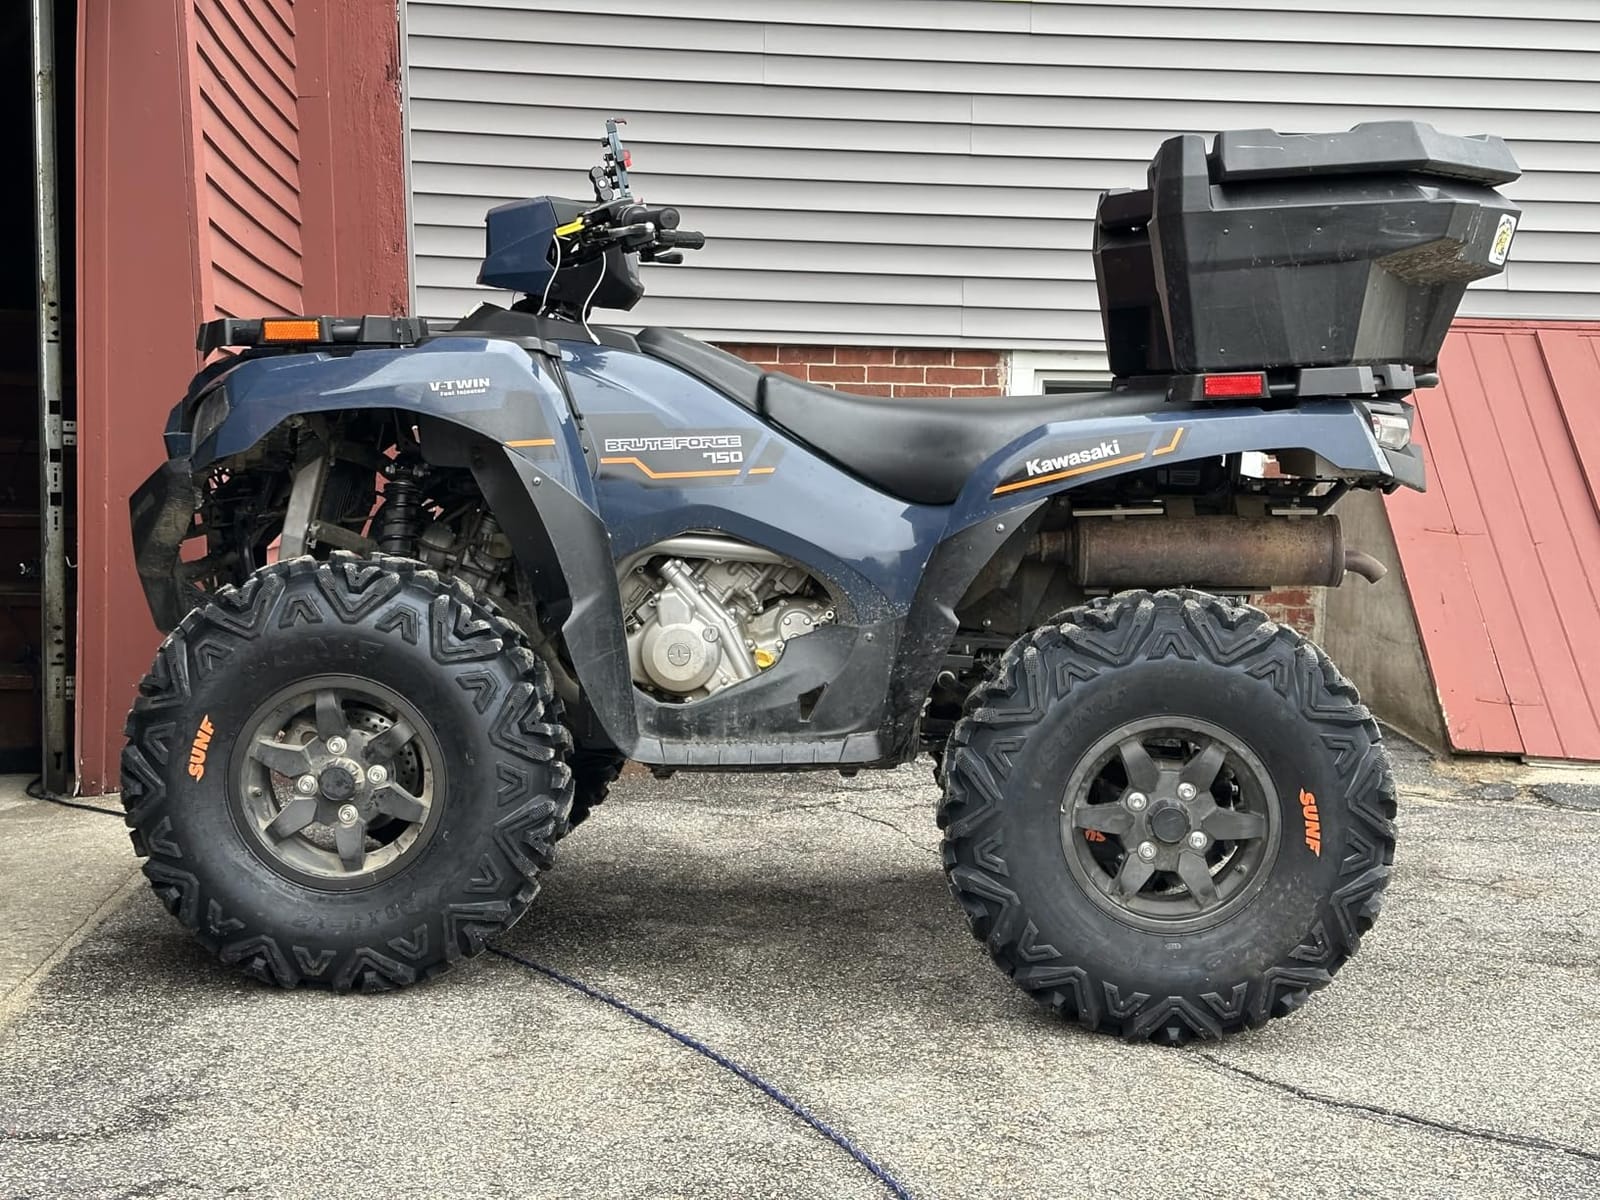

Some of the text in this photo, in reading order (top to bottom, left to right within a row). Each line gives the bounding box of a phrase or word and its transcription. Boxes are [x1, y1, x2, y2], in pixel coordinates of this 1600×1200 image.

[429, 378, 490, 391] V-TWIN
[703, 451, 743, 464] 750
[1025, 440, 1121, 477] Kawasaki
[188, 714, 215, 782] SUNF
[1300, 788, 1321, 858] SUNF
